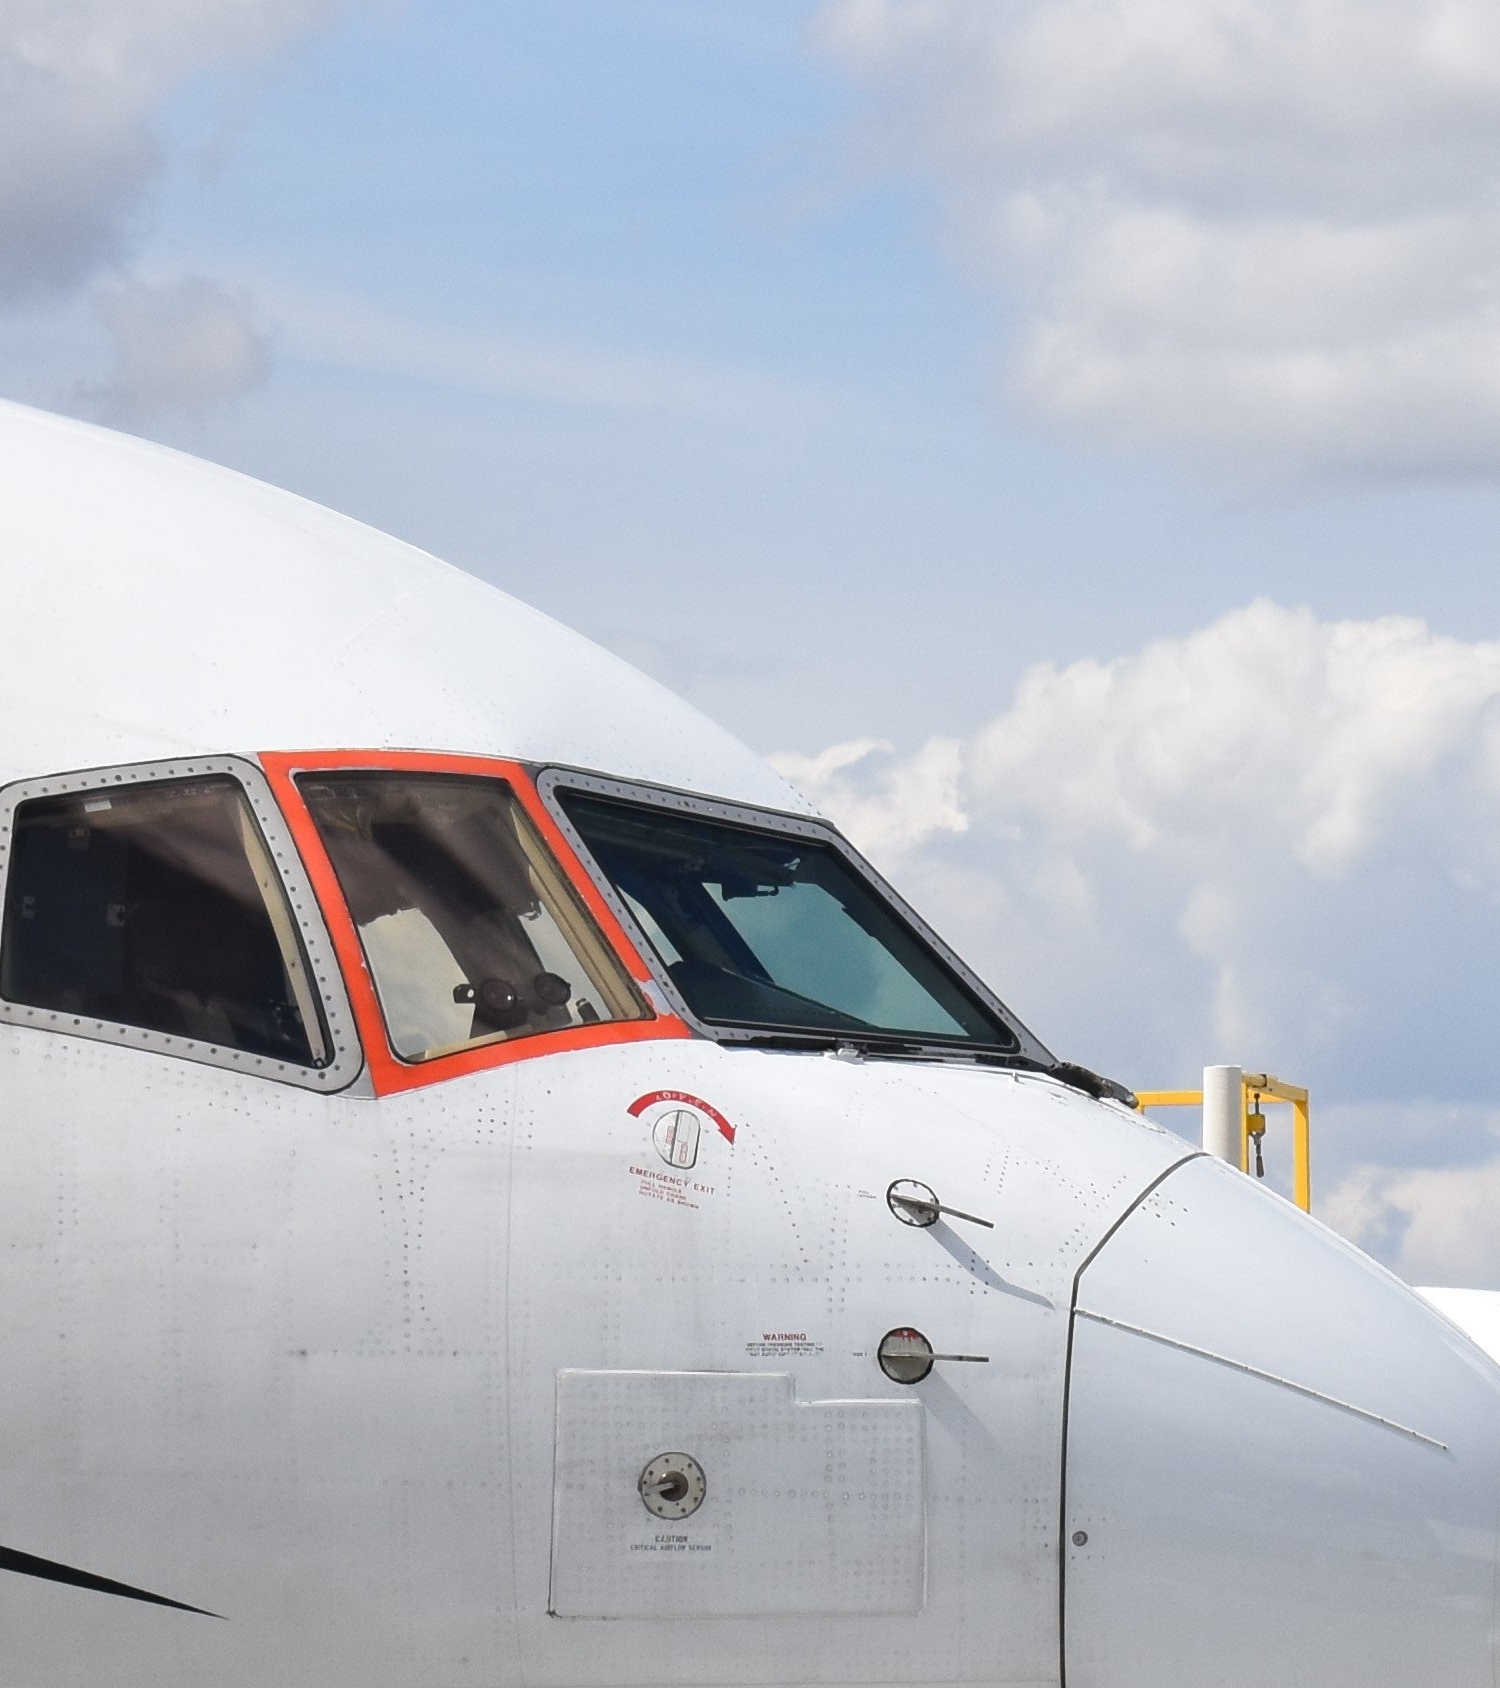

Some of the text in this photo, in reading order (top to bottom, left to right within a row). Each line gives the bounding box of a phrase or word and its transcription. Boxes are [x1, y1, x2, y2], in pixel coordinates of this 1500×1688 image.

[629, 1165, 716, 1195] EMERGENCY EXIT
[762, 1333, 807, 1341] WARNING
[654, 1535, 689, 1543] CAUTION
